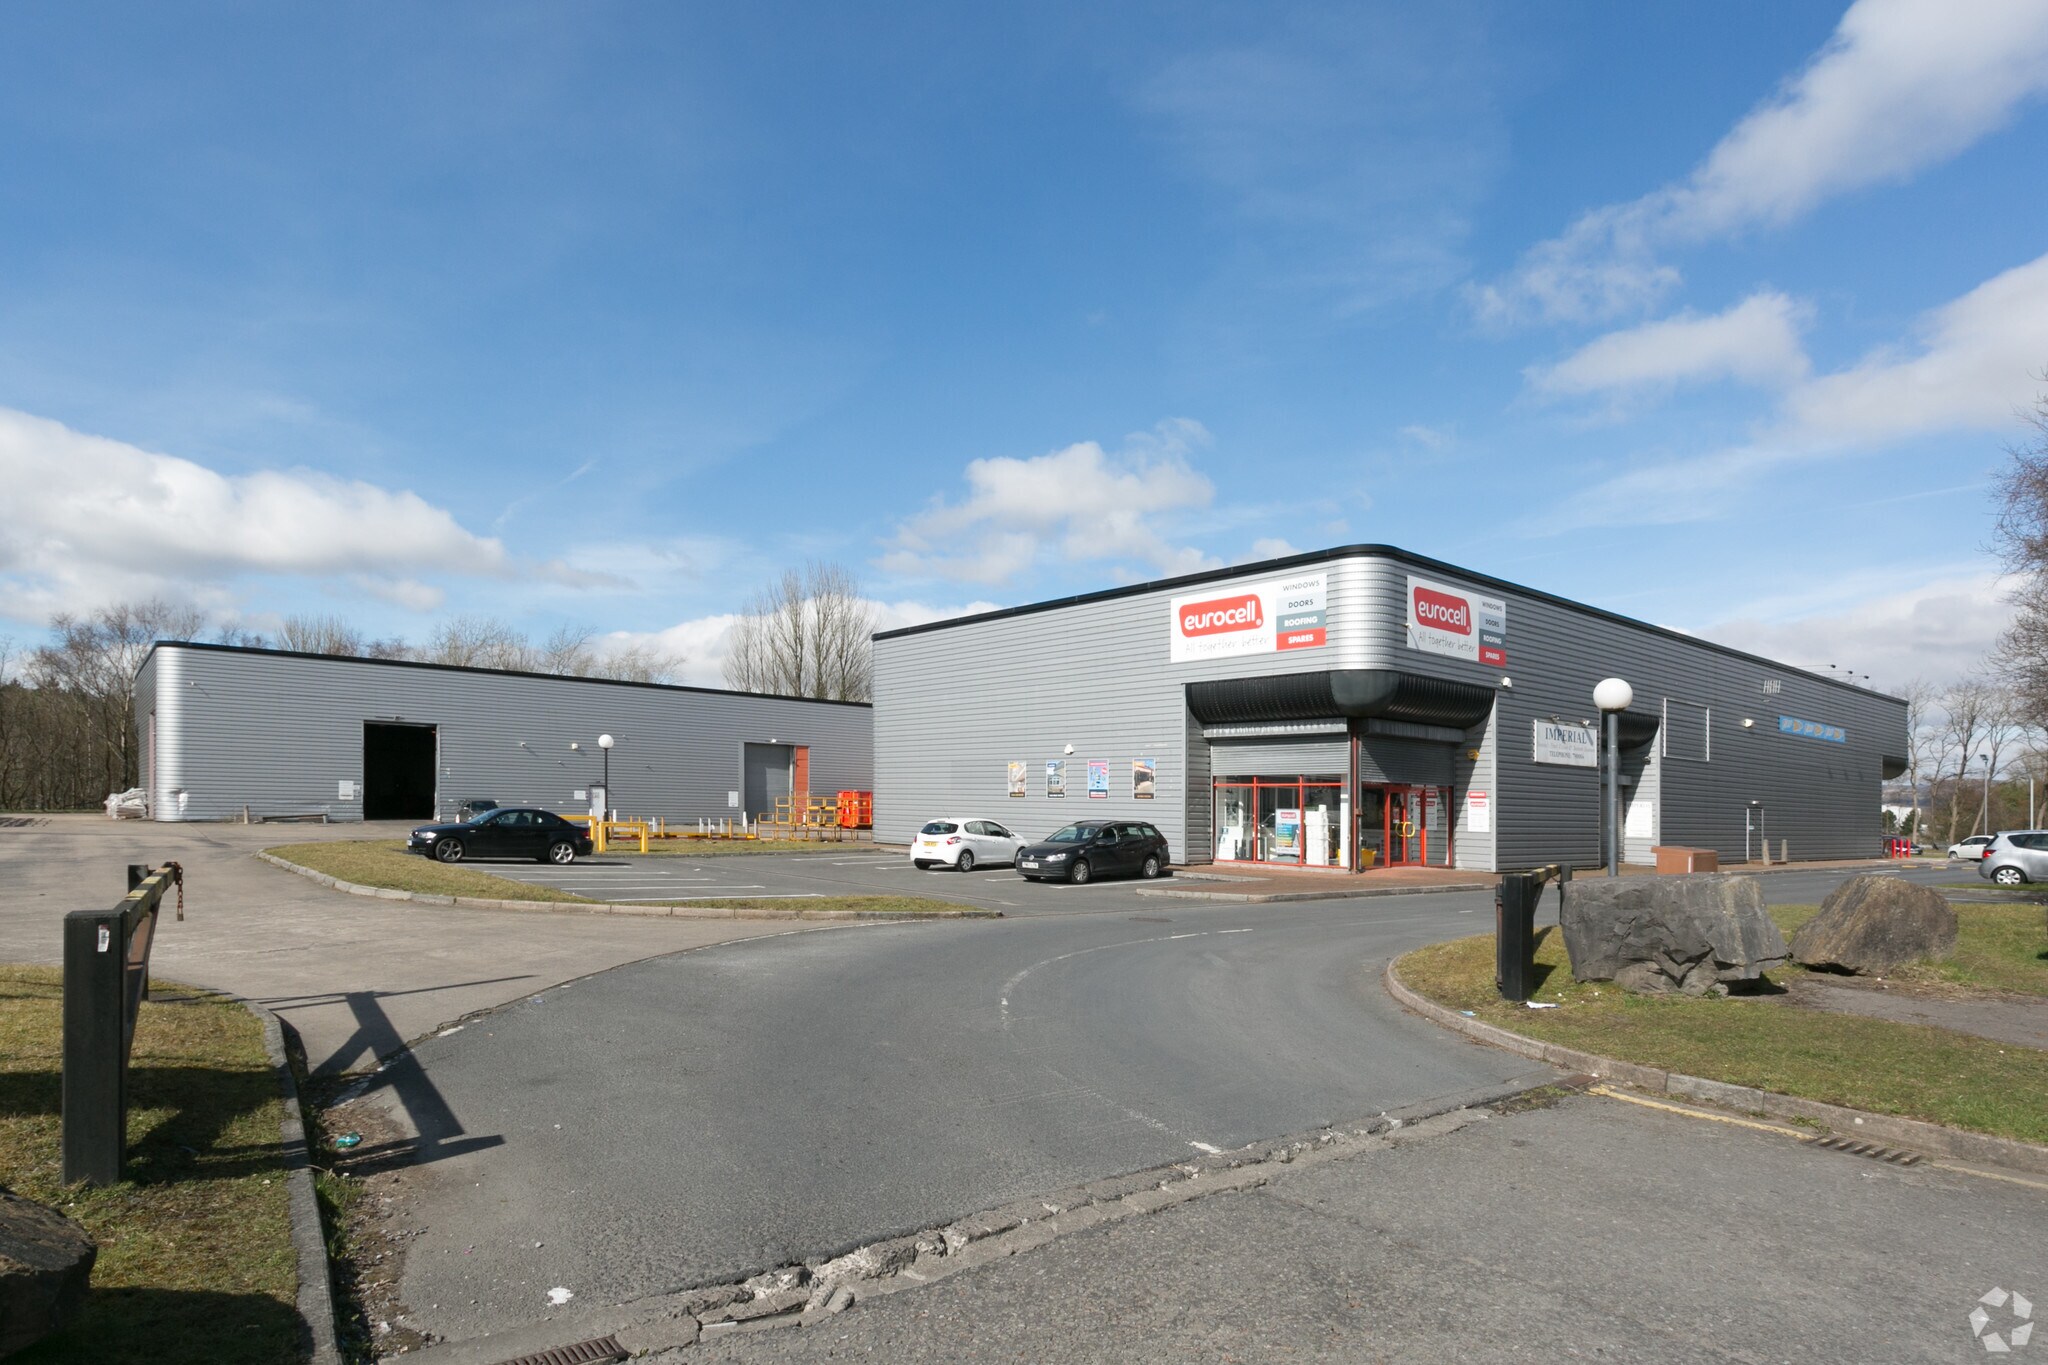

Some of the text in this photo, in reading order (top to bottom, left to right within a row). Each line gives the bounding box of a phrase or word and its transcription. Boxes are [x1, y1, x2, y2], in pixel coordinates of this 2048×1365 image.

[1282, 580, 1320, 591] WINDOWS
[1288, 599, 1314, 609] DOORS
[1482, 601, 1503, 611] WINDOWS
[1184, 600, 1256, 630] eurocell
[1418, 601, 1467, 626] eurocell
[1284, 616, 1318, 627] ROOFING
[1485, 618, 1500, 628] DOORS
[1199, 638, 1235, 653] together
[1242, 636, 1268, 647] better
[1288, 634, 1314, 645] SPARES
[1428, 632, 1456, 649] together
[1545, 727, 1587, 744] IMPERIAL
